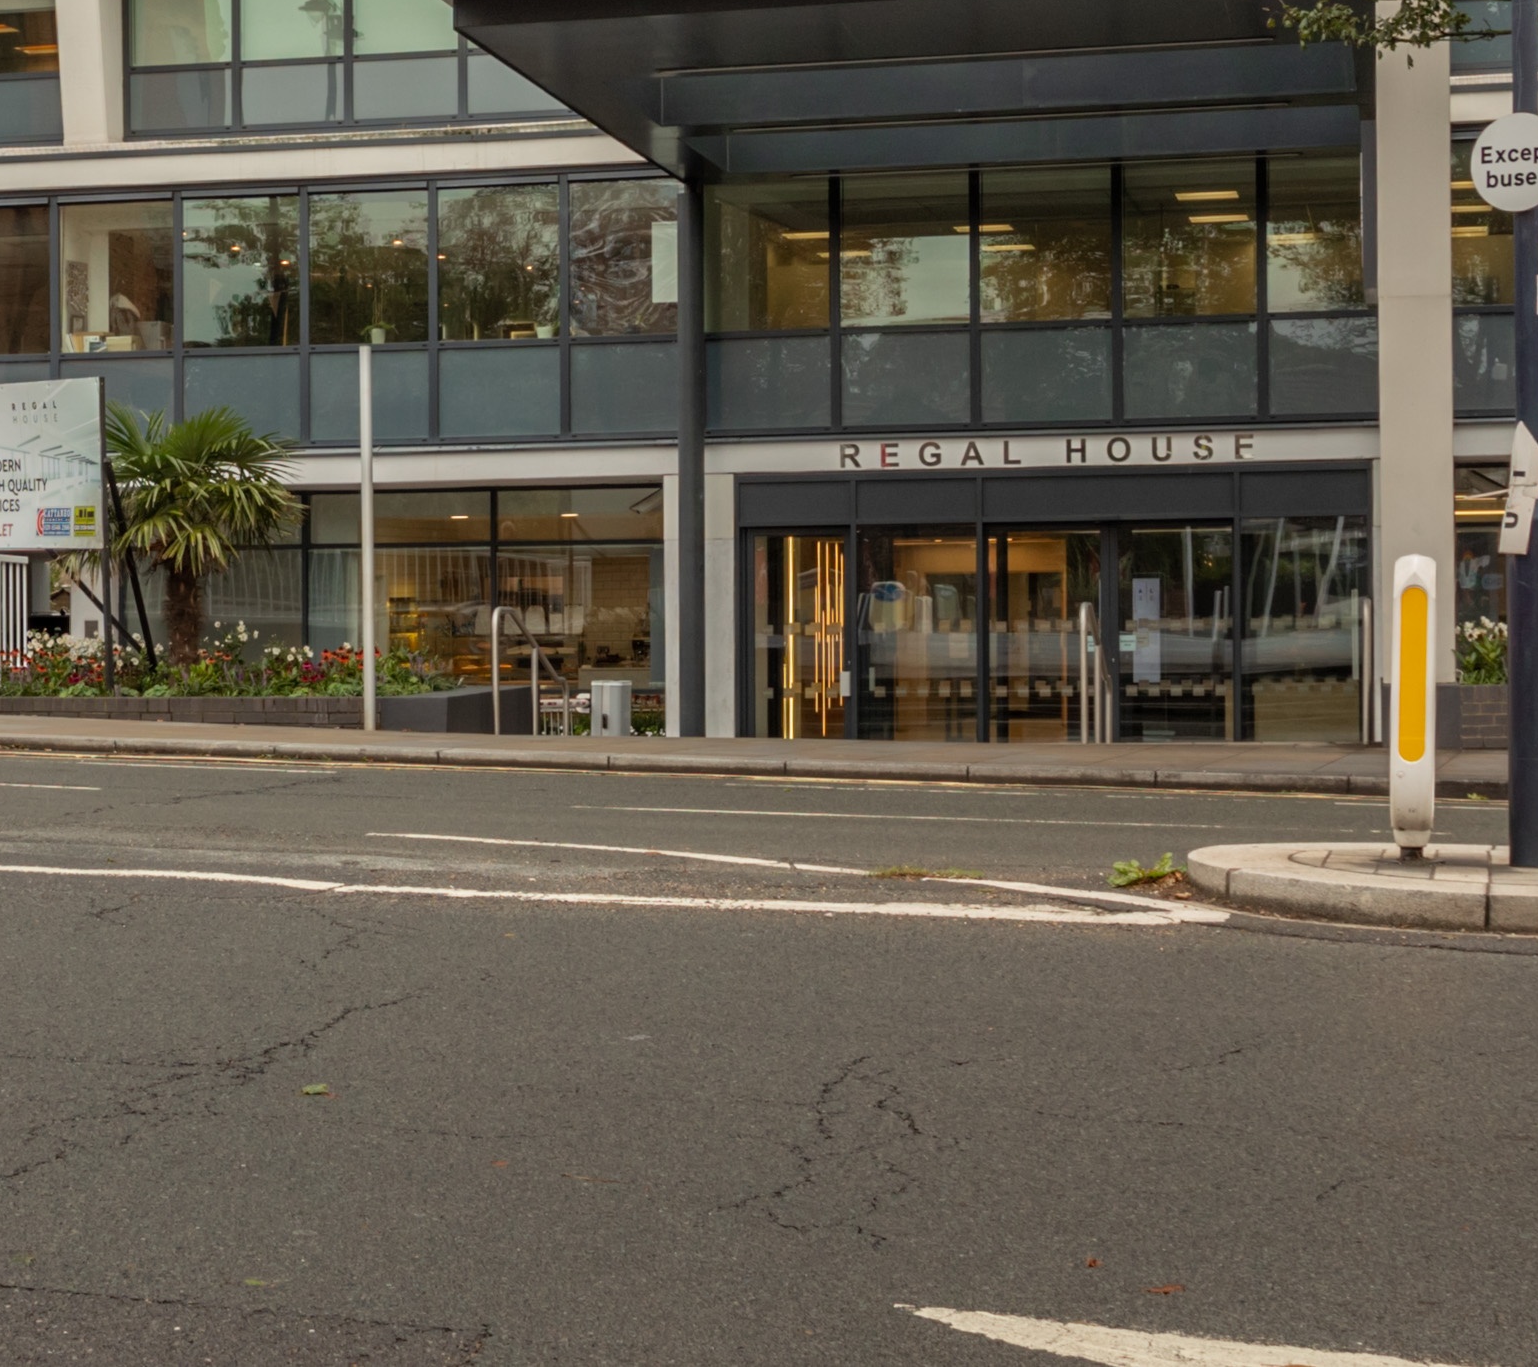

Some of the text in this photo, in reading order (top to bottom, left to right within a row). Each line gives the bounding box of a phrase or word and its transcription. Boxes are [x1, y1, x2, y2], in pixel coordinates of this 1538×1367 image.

[11, 400, 58, 411] REGAL
[12, 413, 59, 424] HOUSE
[839, 434, 1255, 469] REGAL HOUSE
[7, 478, 48, 496] QUALITY
